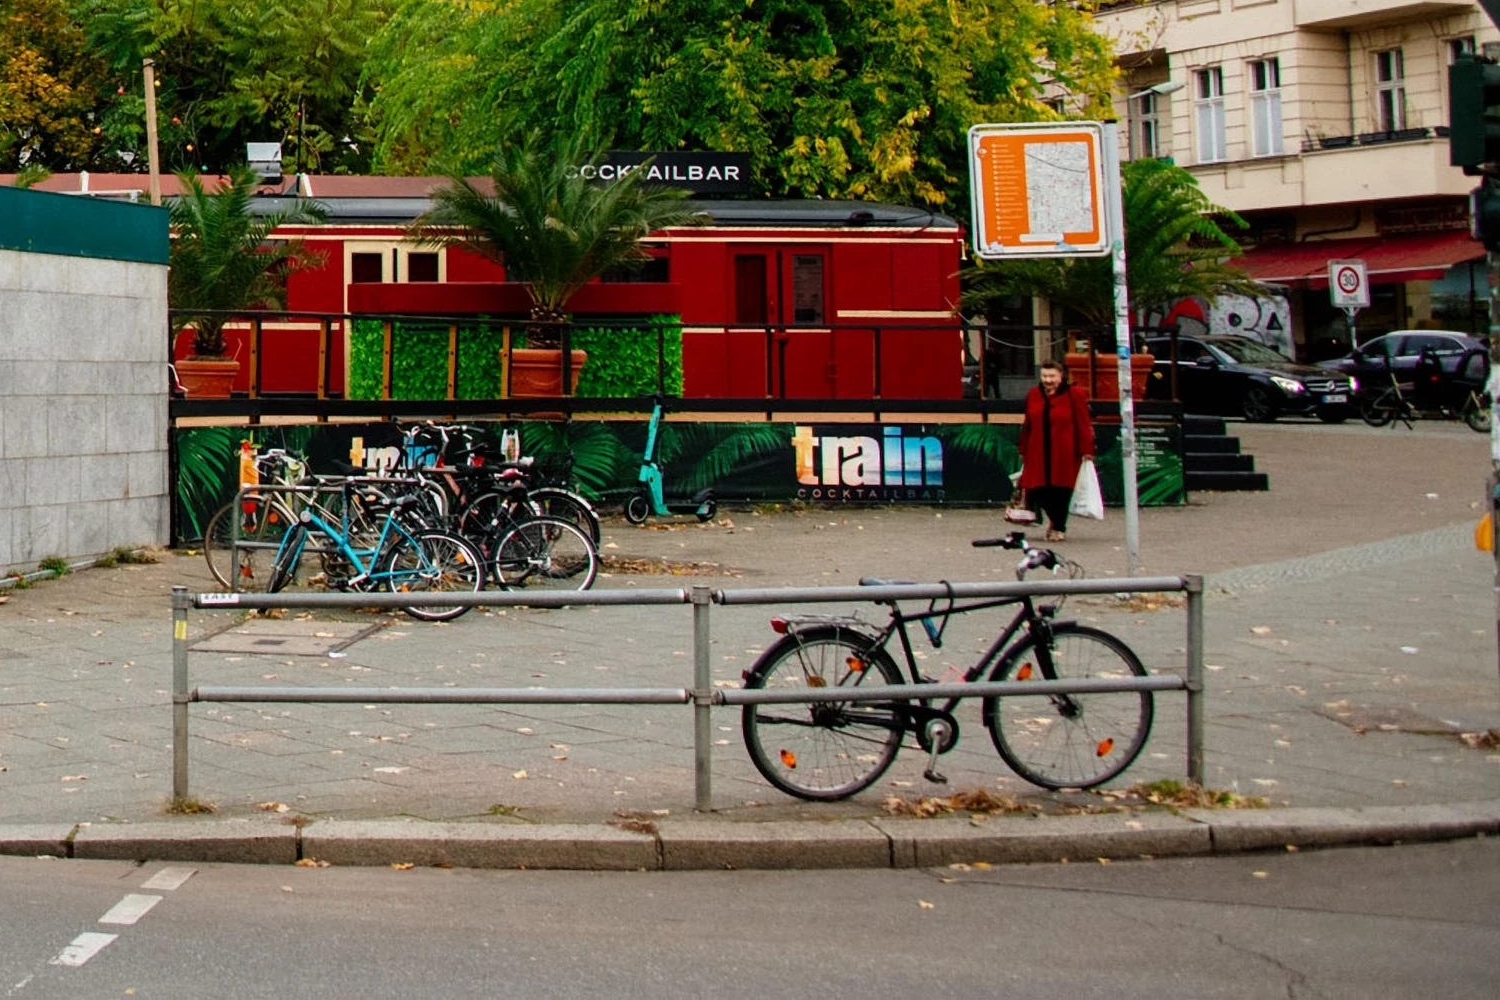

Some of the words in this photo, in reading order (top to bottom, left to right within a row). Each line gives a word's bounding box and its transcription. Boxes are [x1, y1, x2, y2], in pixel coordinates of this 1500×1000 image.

[1343, 274, 1356, 287] 30
[792, 427, 943, 486] train
[797, 489, 945, 499] COCKTAILBAR
